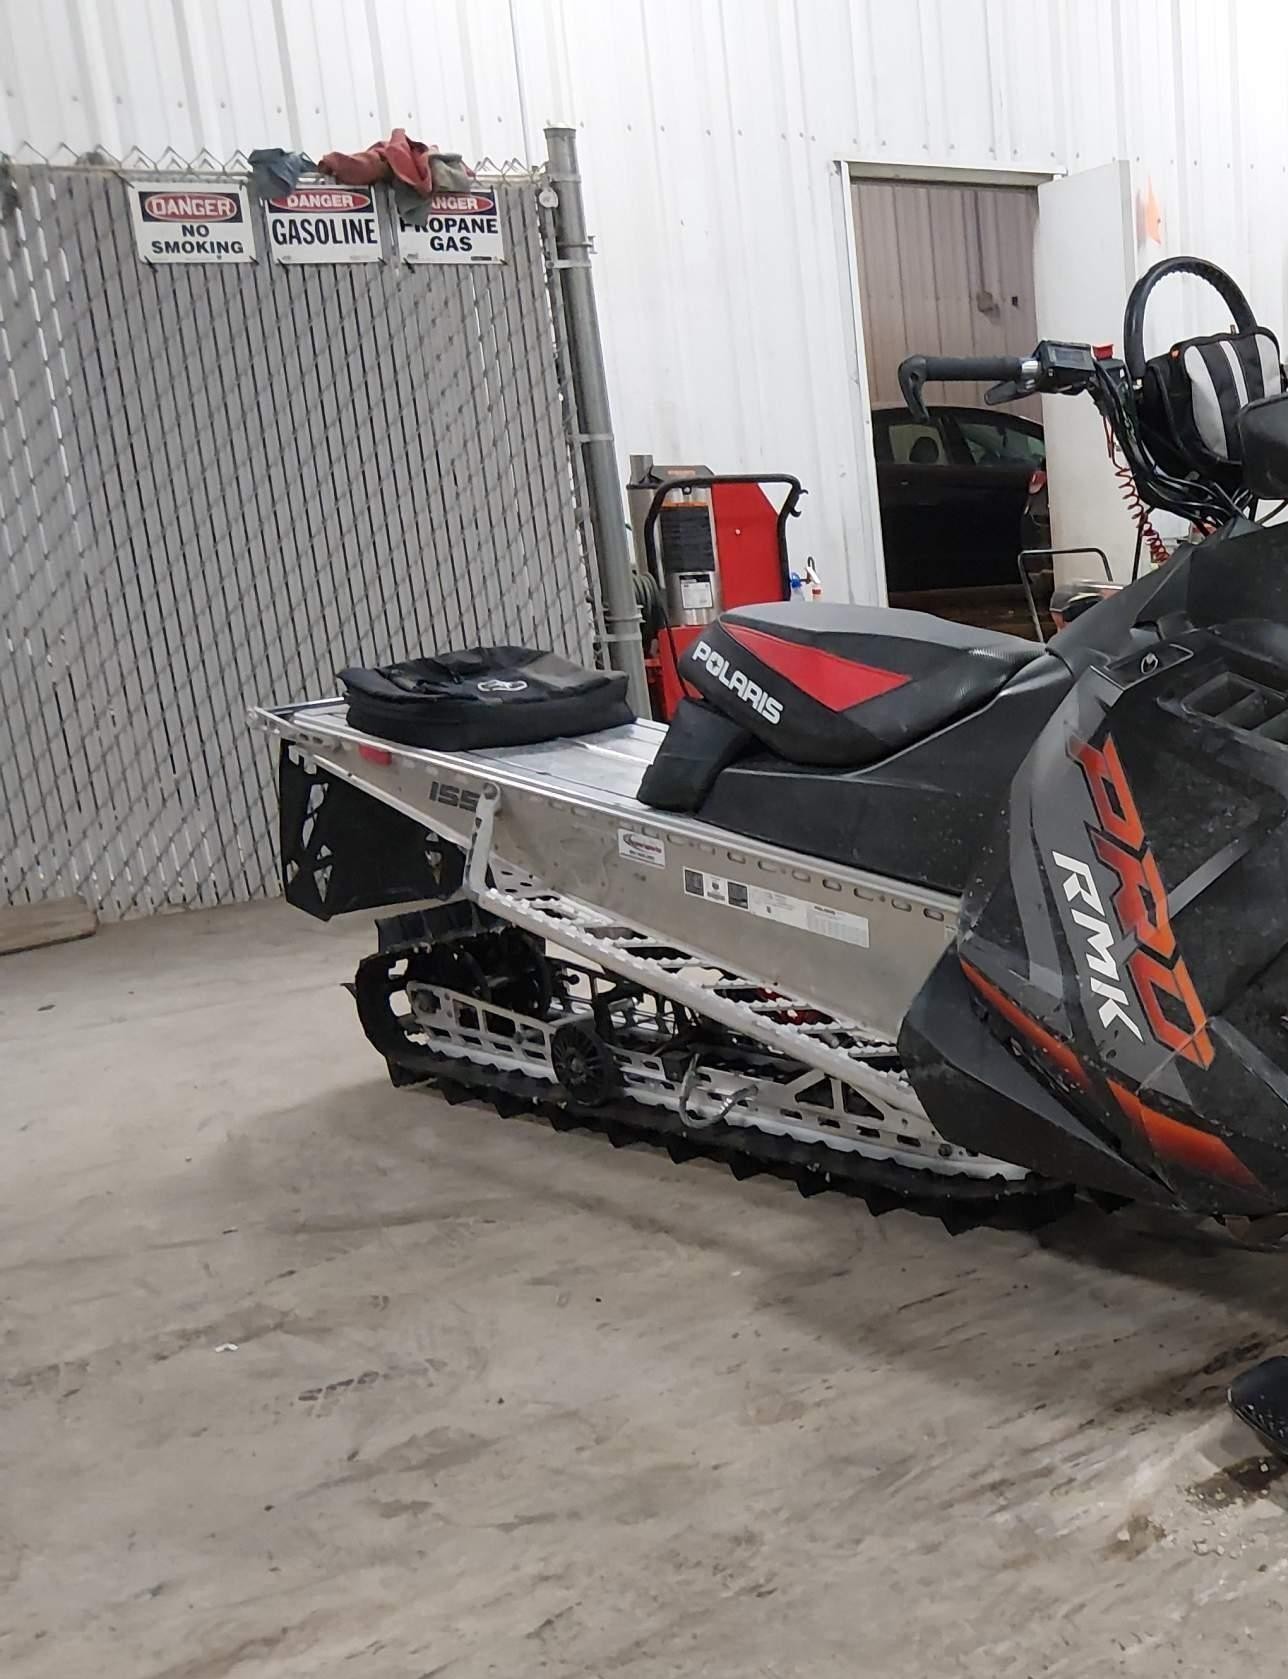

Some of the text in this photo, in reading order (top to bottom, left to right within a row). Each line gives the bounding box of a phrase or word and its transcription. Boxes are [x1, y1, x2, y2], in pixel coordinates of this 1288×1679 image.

[151, 198, 231, 217] DANGER
[286, 194, 354, 208] DANGER
[431, 195, 479, 210] ANGER
[181, 224, 210, 238] NO
[271, 218, 378, 245] GASOLINE
[151, 240, 244, 254] SMOKING
[429, 236, 473, 252] GAS
[692, 640, 784, 725] POLARIS
[1066, 732, 1216, 1071] PRO
[1051, 850, 1144, 1043] RMK
